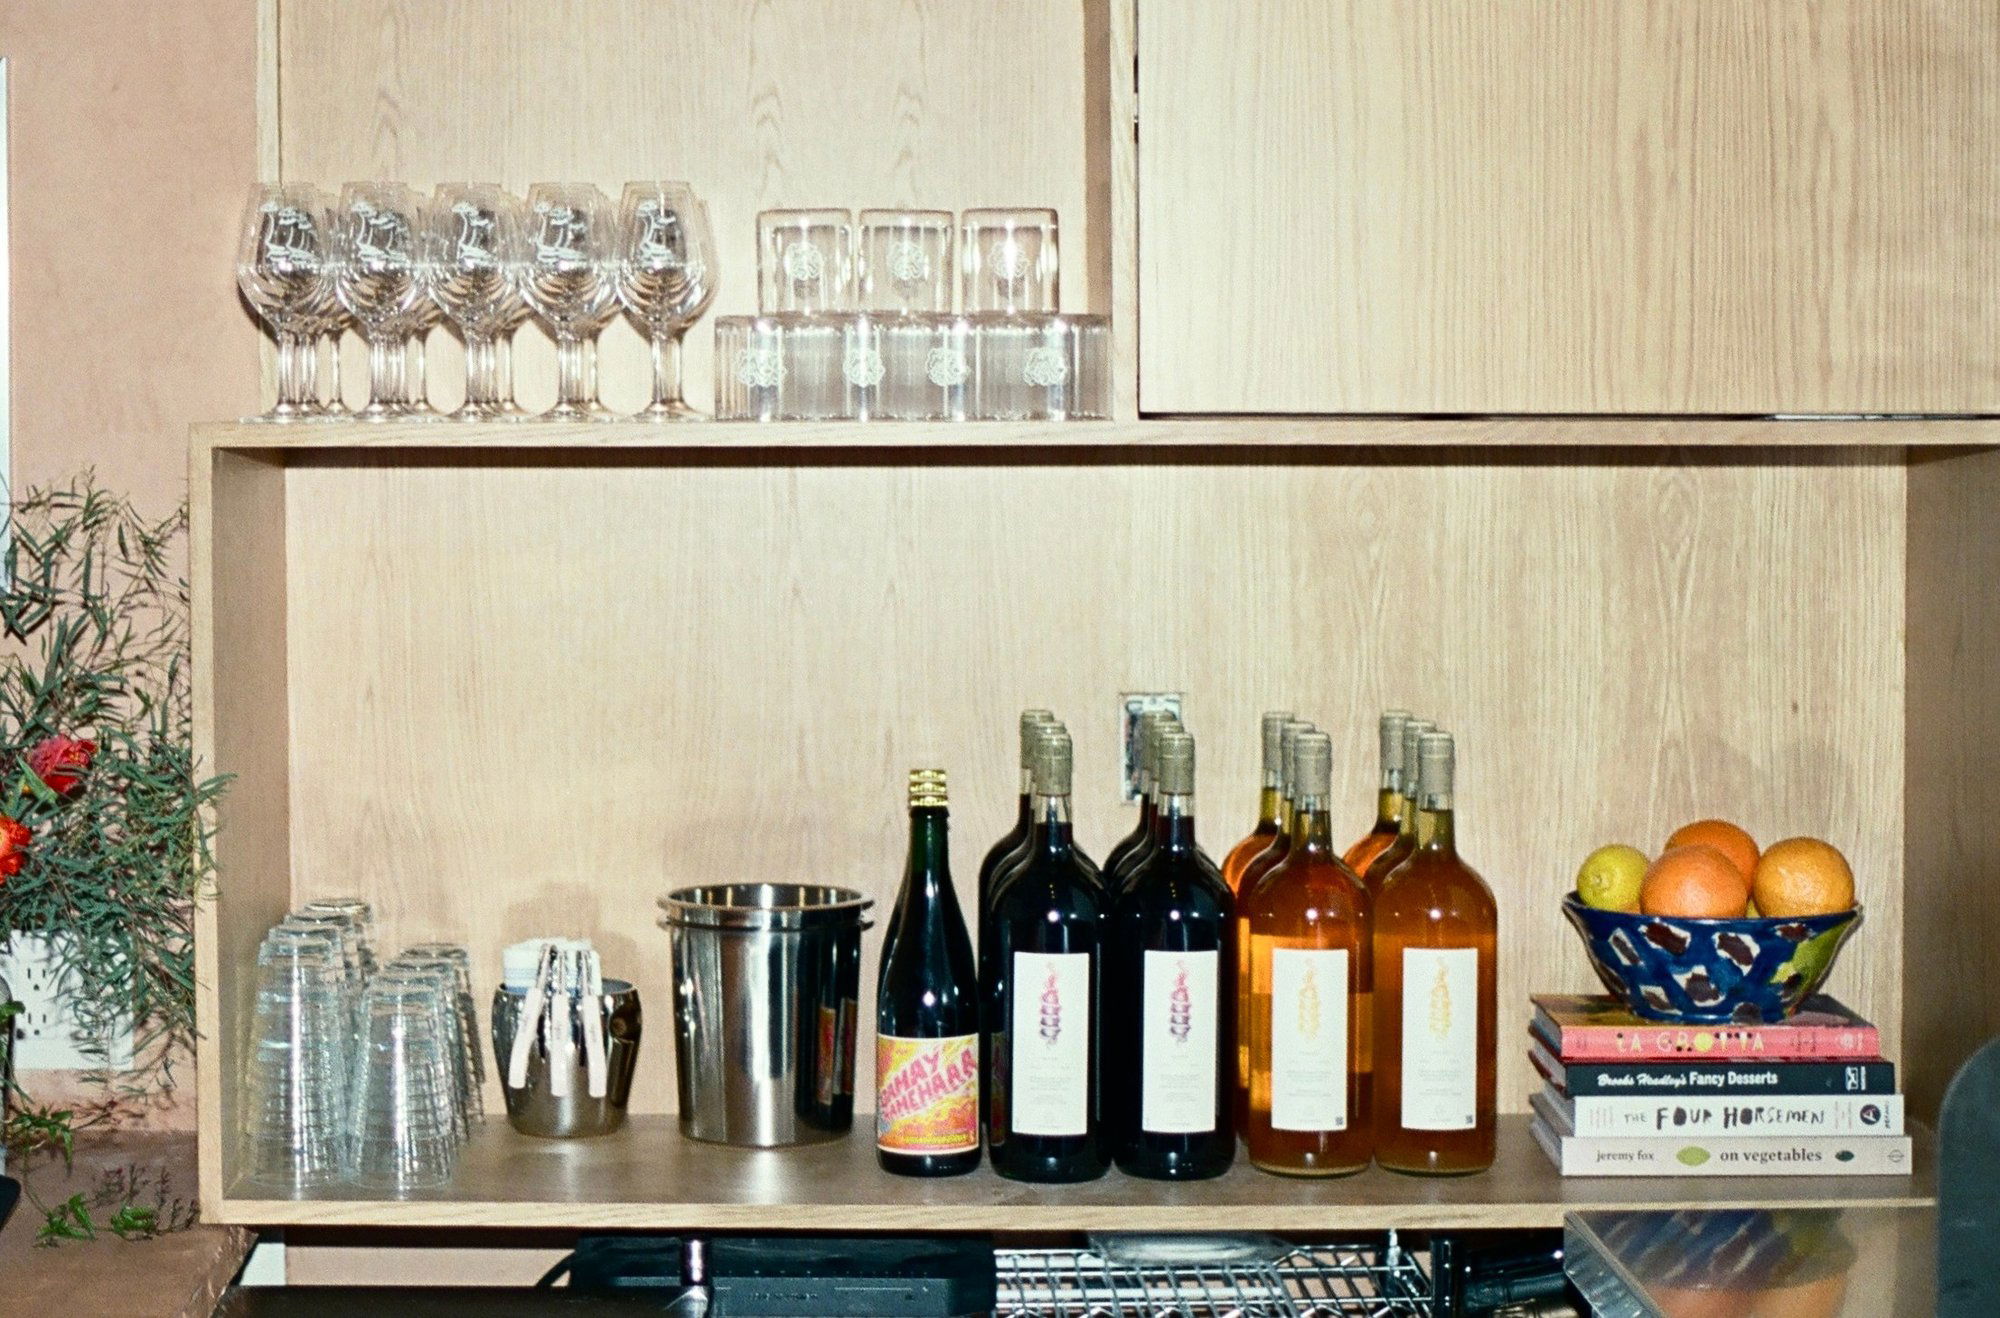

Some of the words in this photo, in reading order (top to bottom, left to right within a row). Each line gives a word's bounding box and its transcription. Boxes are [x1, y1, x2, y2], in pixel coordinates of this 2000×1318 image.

[1597, 1073, 1635, 1087] Brooks
[1636, 1072, 1688, 1088] Headley's
[1689, 1071, 1725, 1087] Fancy
[1727, 1071, 1779, 1086] Desserts
[1624, 1112, 1649, 1124] THE
[1656, 1106, 1713, 1131] FOUR
[1723, 1105, 1825, 1130] HORSEMEN
[1596, 1150, 1634, 1163] jeremy
[1637, 1149, 1655, 1161] fox
[1719, 1151, 1739, 1162] on
[1743, 1147, 1823, 1165] vegetables
